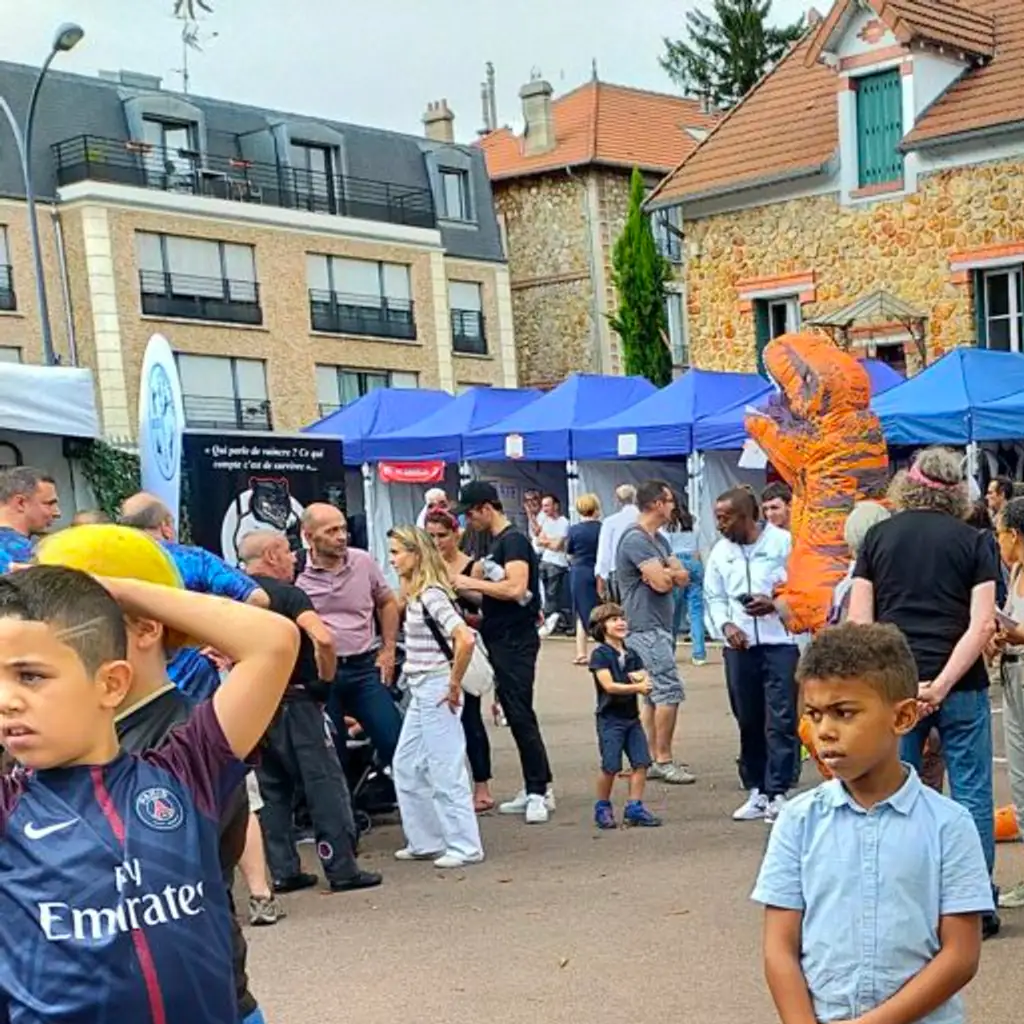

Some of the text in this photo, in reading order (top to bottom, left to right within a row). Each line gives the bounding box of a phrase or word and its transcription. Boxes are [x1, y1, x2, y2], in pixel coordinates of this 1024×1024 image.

[212, 444, 227, 457] Qui
[250, 446, 260, 455] de
[311, 448, 324, 459] qui
